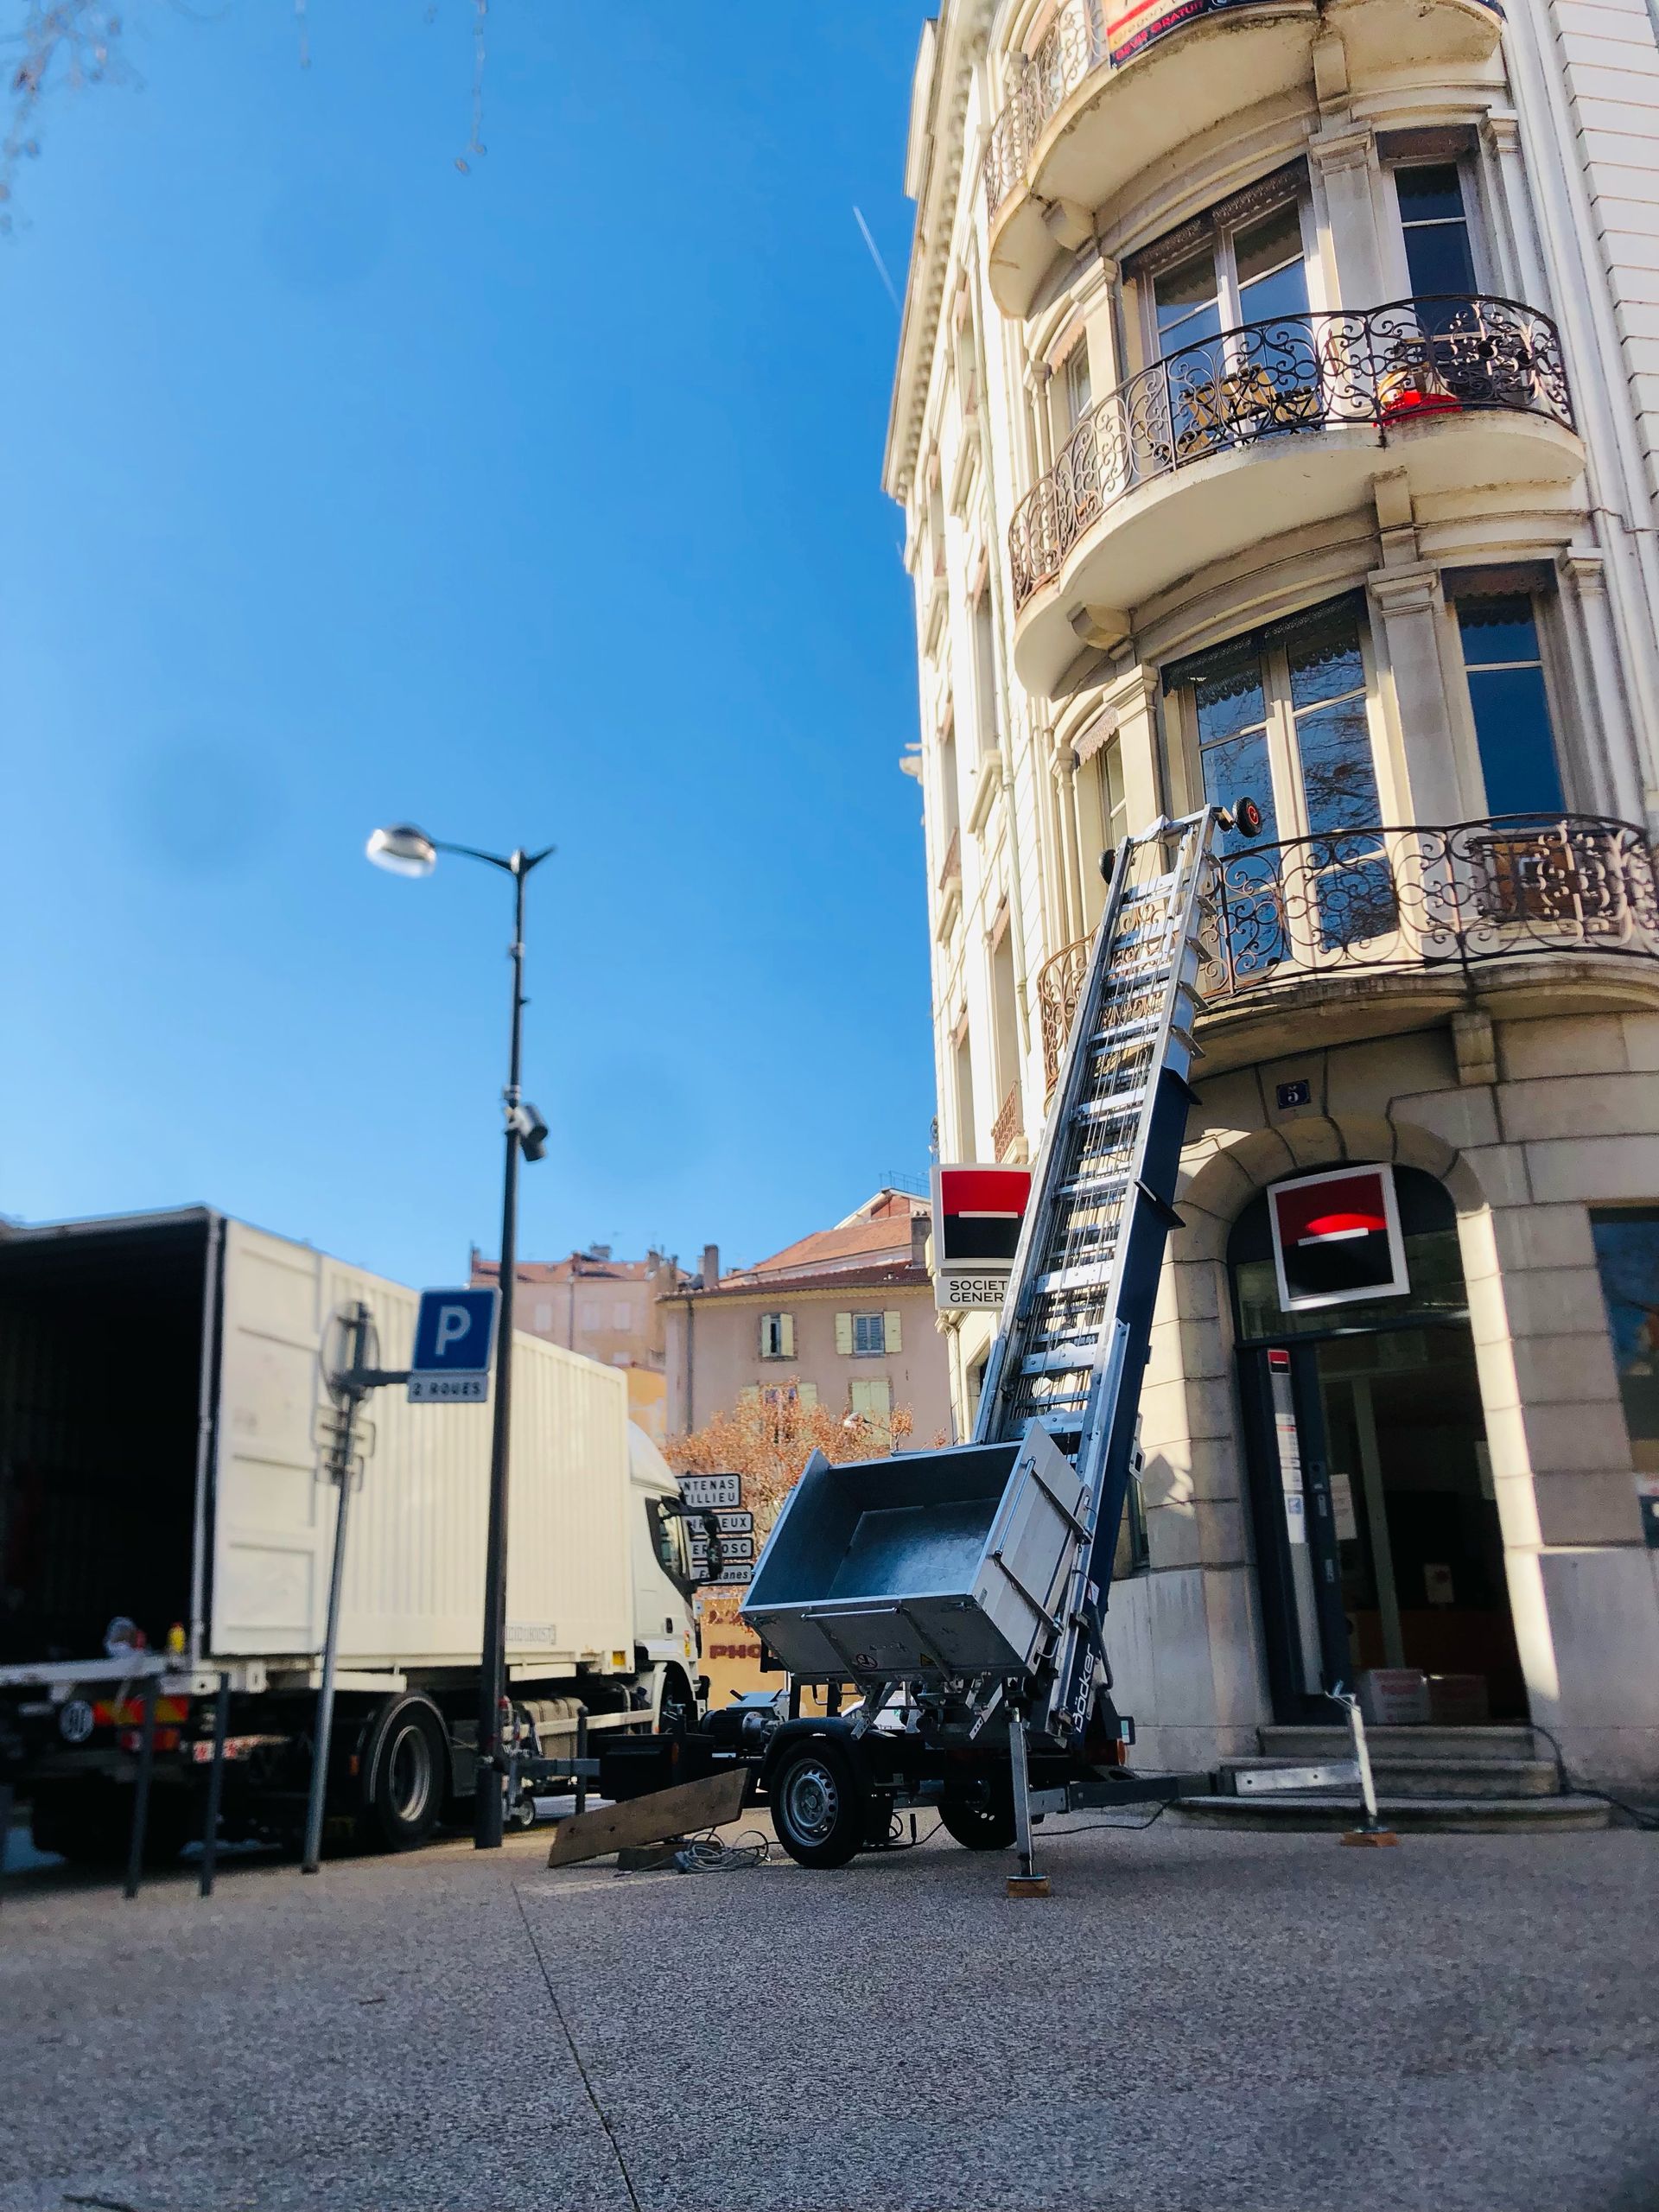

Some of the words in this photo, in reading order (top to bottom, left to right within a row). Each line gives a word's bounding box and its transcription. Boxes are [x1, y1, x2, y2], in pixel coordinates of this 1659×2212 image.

[1287, 1085, 1299, 1103] 5
[950, 1281, 1007, 1290] SOCIET
[950, 1293, 1004, 1302] GENER
[435, 1306, 472, 1357] P
[693, 1543, 747, 1555] EROSC
[709, 1643, 761, 1659] PHO
[1072, 1643, 1095, 1733] Böcker
